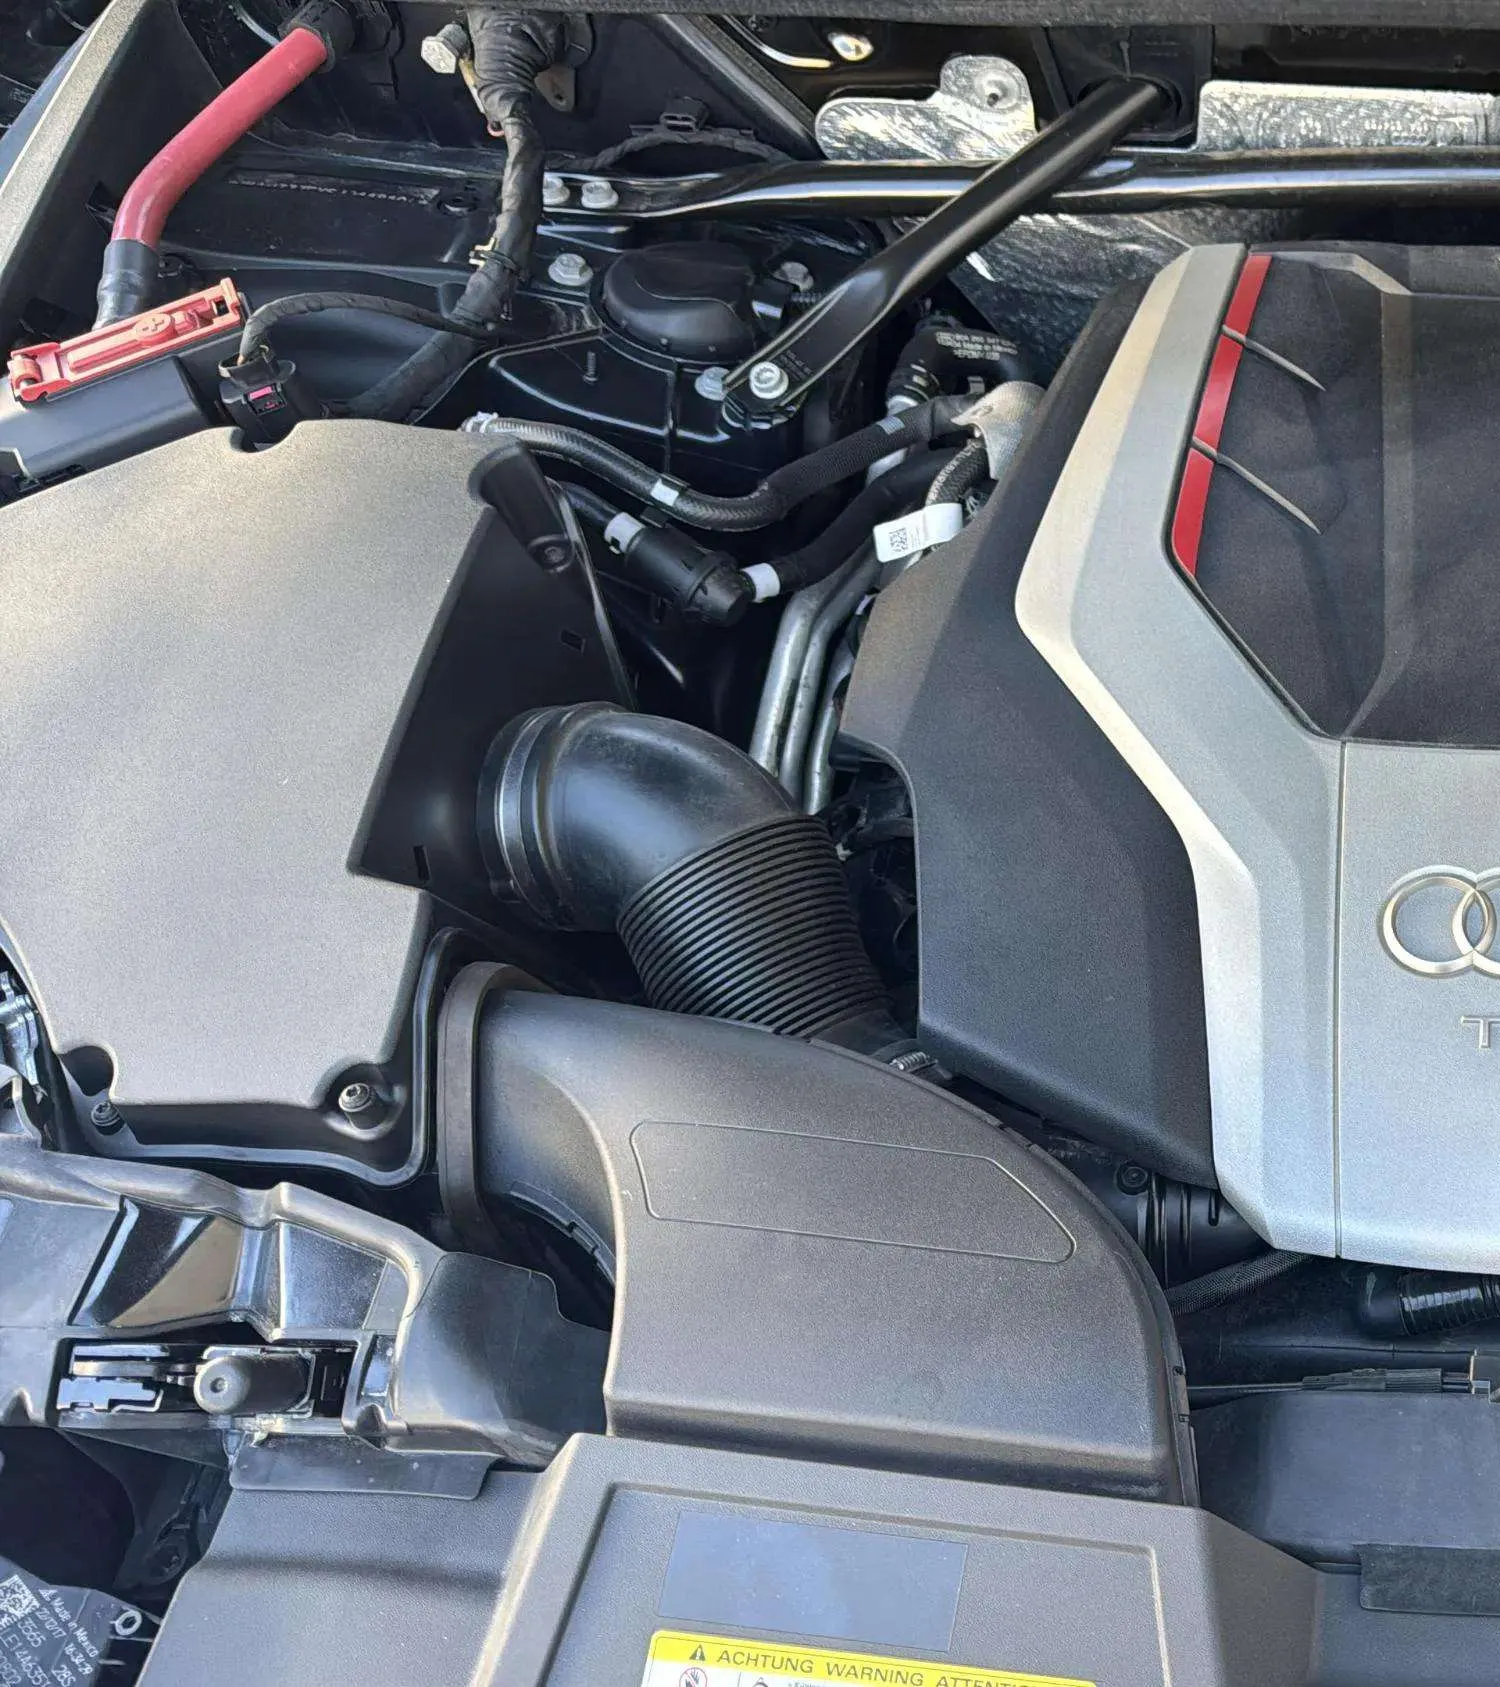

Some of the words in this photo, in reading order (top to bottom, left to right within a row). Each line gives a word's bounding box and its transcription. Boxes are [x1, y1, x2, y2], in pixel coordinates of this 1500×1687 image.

[73, 1627, 99, 1658] Mexico
[717, 1650, 814, 1674] ACHTUNG
[826, 1662, 924, 1687] WARNING
